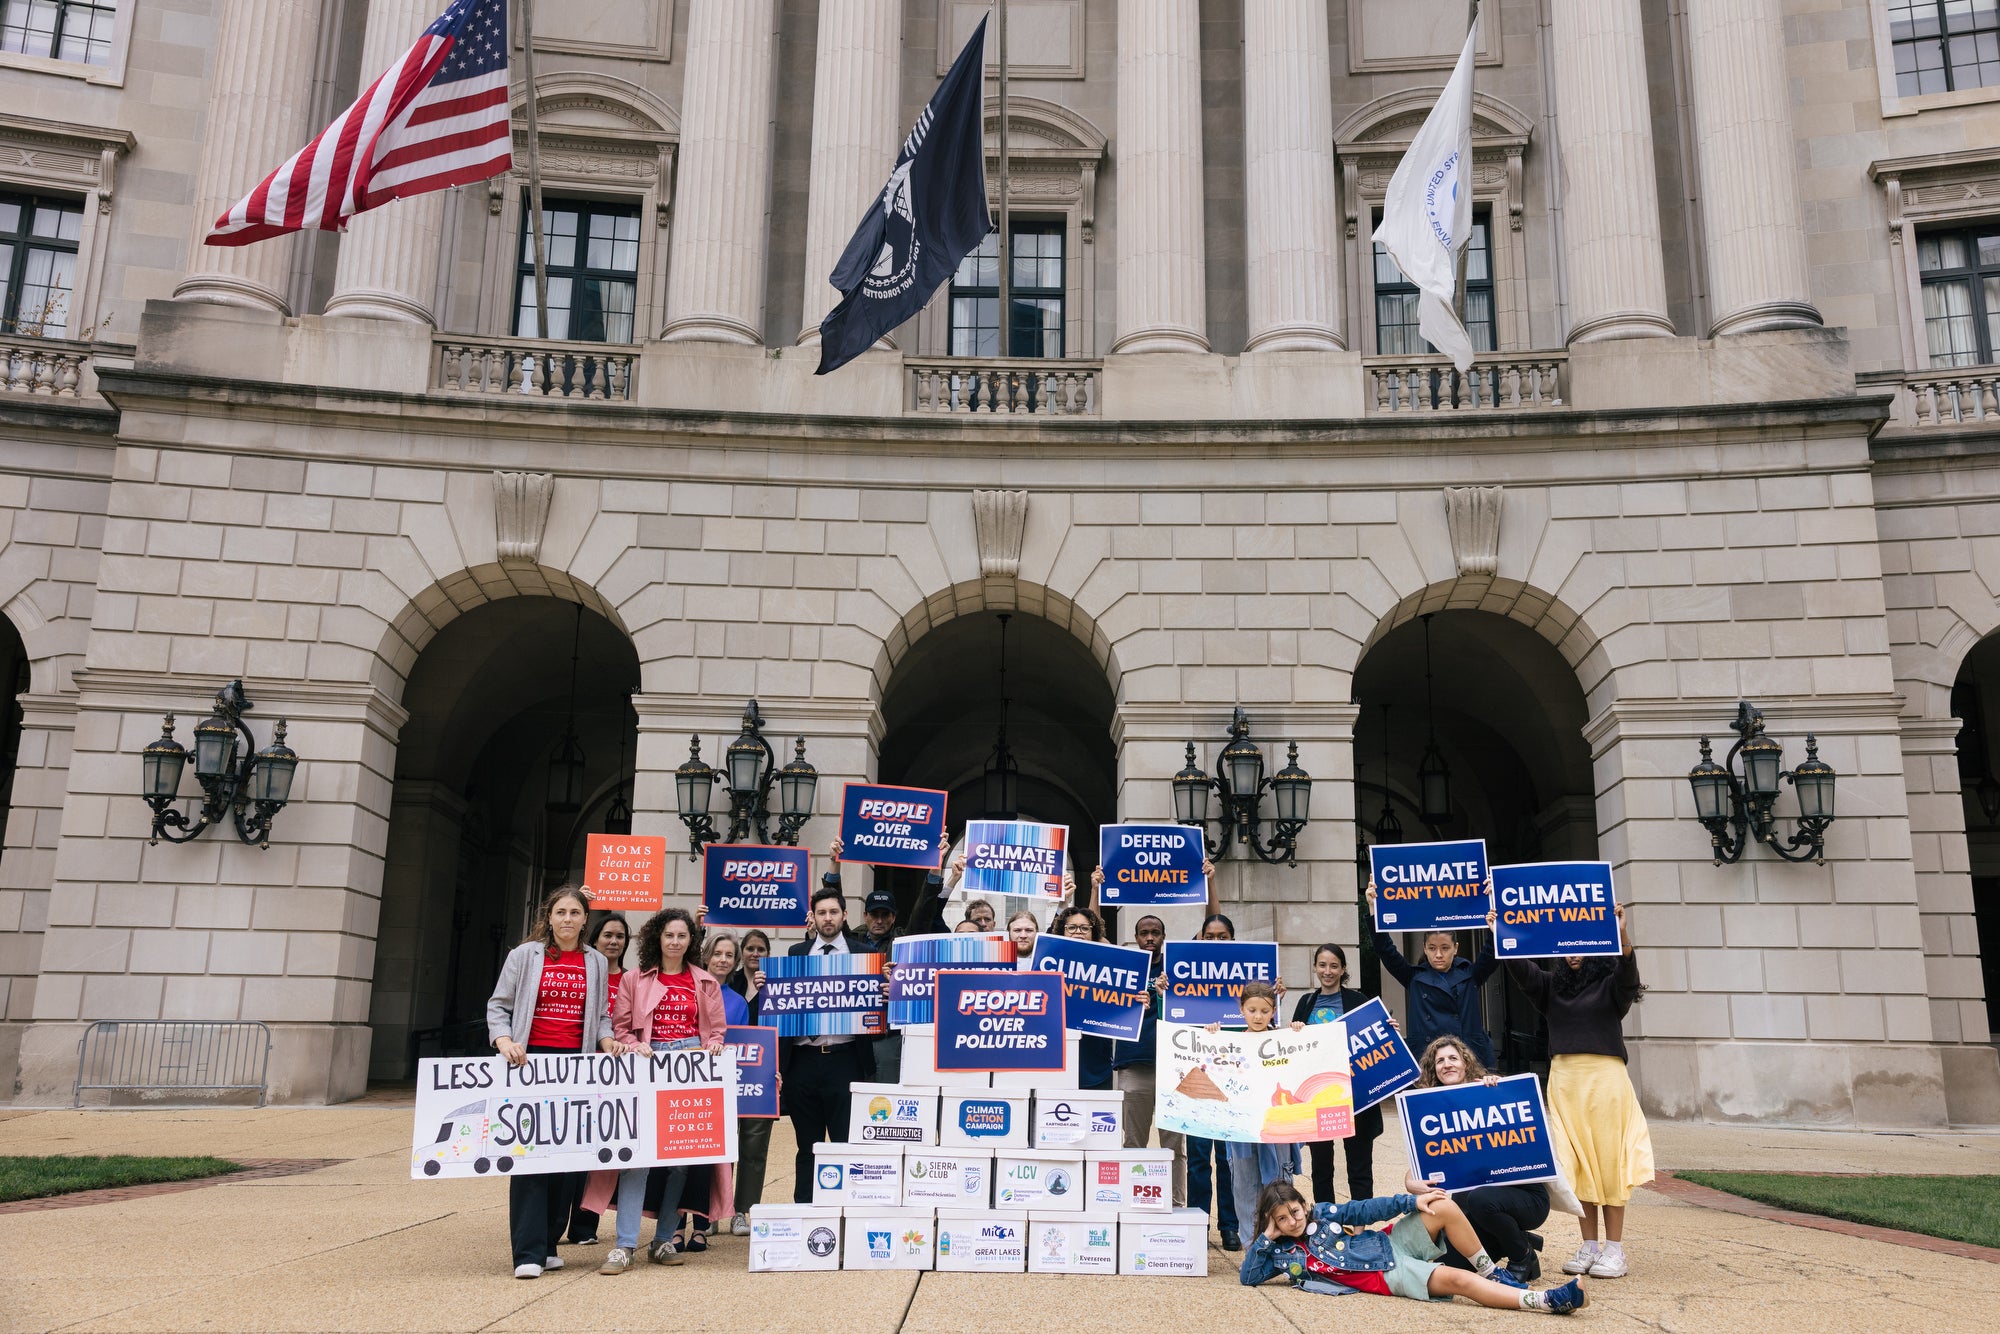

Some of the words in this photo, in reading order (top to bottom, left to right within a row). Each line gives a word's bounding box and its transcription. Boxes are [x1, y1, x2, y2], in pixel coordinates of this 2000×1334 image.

[1427, 170, 1444, 206] UNITED
[859, 799, 930, 822] PEOPLE
[874, 822, 911, 836] OVER
[854, 834, 929, 851] POLLUTERS
[1121, 834, 1186, 849] DEFEND
[601, 844, 651, 855] MOMS
[975, 844, 1056, 864] CLIMATE
[600, 856, 630, 868] clean
[634, 858, 652, 869] air
[1135, 852, 1172, 866] OUR
[724, 861, 795, 880] PEOPLE
[974, 859, 1017, 871] CAN'T
[1020, 861, 1055, 875] WAIT
[1381, 861, 1479, 883] CLIMATE
[598, 872, 651, 882] FORCE
[1117, 869, 1189, 884] CLIMATE
[740, 884, 779, 895] OVER
[1383, 886, 1434, 901] CAN'T
[1436, 883, 1480, 899] WAIT
[1501, 884, 1605, 906] CLIMATE
[719, 897, 797, 910] POLLUTERS
[1435, 914, 1486, 922] ActOnClimate.com
[1503, 908, 1555, 925] CAN'T
[1559, 906, 1607, 922] WAIT
[545, 972, 584, 981] MOMS
[894, 968, 926, 981] CUT
[1040, 956, 1139, 990] CLIMATE
[1173, 961, 1269, 981] CLIMATE
[542, 979, 569, 988] clean
[767, 983, 791, 996] WE
[794, 980, 846, 994] STAND
[848, 979, 880, 993] FOR
[1173, 983, 1224, 997] CAN'T
[541, 990, 585, 1000] FORCE
[661, 994, 687, 1002] OMS
[958, 991, 1045, 1013] PEOPLE
[1092, 987, 1135, 1008] WAIT
[674, 1003, 688, 1011] air
[762, 998, 775, 1011] A
[777, 996, 814, 1011] SAFE
[817, 994, 883, 1009] CLIMATE
[979, 1018, 1025, 1032] OVER
[1083, 1018, 1133, 1031] ActOnClimate.com
[955, 1034, 1048, 1049] POLLUTERS
[1172, 1029, 1241, 1054] Climate
[1258, 1038, 1319, 1059] Change
[1355, 1040, 1396, 1071] WAIT
[433, 1062, 493, 1091] LESS
[506, 1054, 635, 1088] POLLUTION
[650, 1051, 723, 1083] MORE
[1368, 1068, 1413, 1095] ActOnClimate.com
[669, 1098, 712, 1108] MOMS
[966, 1106, 1004, 1114] CLIMATE
[669, 1109, 695, 1120] clean
[698, 1109, 712, 1119] air
[897, 1106, 918, 1117] AIR
[966, 1114, 1004, 1123] ACTION
[1420, 1100, 1534, 1137] CLIMATE
[668, 1122, 713, 1132] FORCE
[877, 1128, 921, 1137] EARTHJUSTICE
[1091, 1124, 1116, 1132] SEIU
[1321, 1124, 1348, 1132] FORCE
[1425, 1134, 1483, 1157] CAN'T
[1486, 1126, 1537, 1148] WAIT
[930, 1162, 957, 1171] SIERRA
[1017, 1165, 1037, 1180] LCV
[1490, 1163, 1547, 1176] ActOnClimate.com
[928, 1171, 948, 1179] CLUB
[1133, 1185, 1162, 1198] PSR
